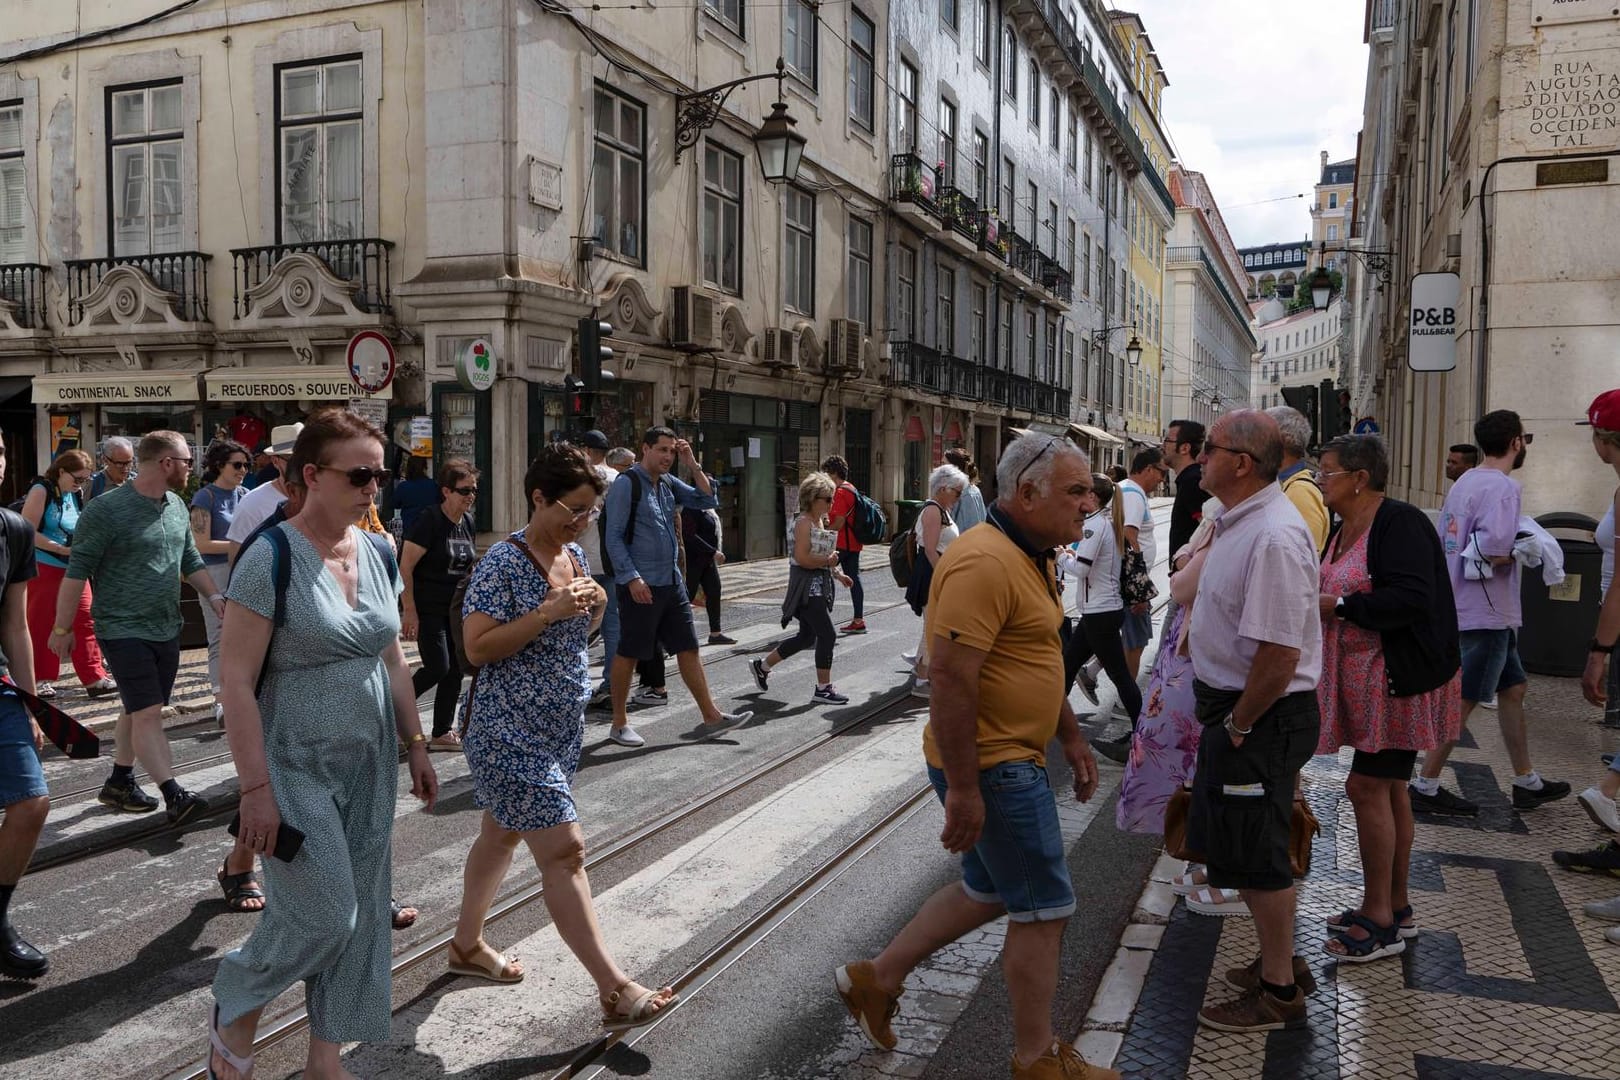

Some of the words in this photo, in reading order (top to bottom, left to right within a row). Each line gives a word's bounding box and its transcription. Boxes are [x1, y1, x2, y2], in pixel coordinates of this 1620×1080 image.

[1554, 61, 1593, 76] RUA
[1525, 73, 1620, 93] AUGUSTA
[1412, 307, 1456, 326] P&B
[1412, 327, 1456, 336] PULL&BEAR
[124, 351, 136, 366] 57
[296, 347, 312, 365] 59
[58, 386, 129, 400] CONTINENTAL
[134, 385, 172, 399] SNACK
[221, 383, 296, 397] RECUERDOS
[306, 383, 376, 395] SOUVENI
[241, 422, 247, 430] 7
